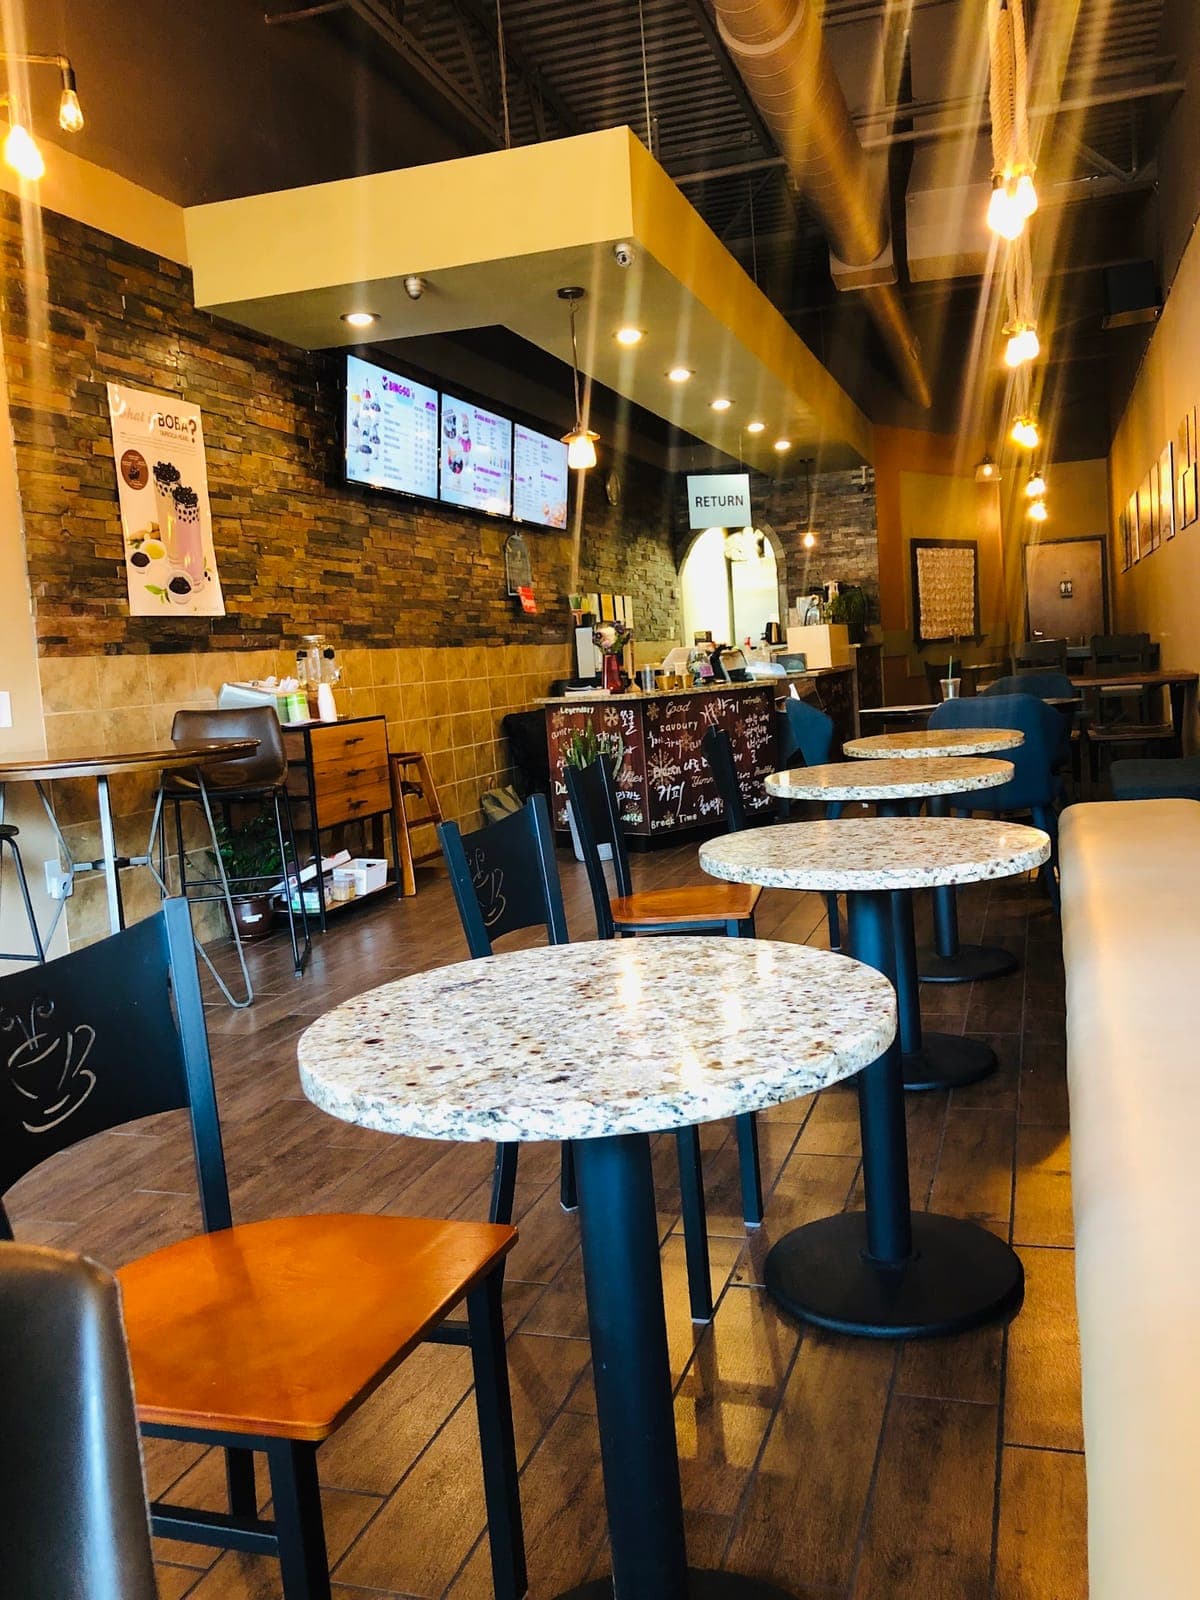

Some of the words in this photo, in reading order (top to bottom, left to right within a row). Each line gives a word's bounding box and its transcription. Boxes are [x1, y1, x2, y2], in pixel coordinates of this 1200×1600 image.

[695, 495, 744, 508] RETURN
[560, 706, 594, 714] Legendary
[666, 700, 692, 718] Good
[660, 720, 698, 733] savoury
[651, 817, 675, 829] Break
[678, 814, 698, 824] Time
